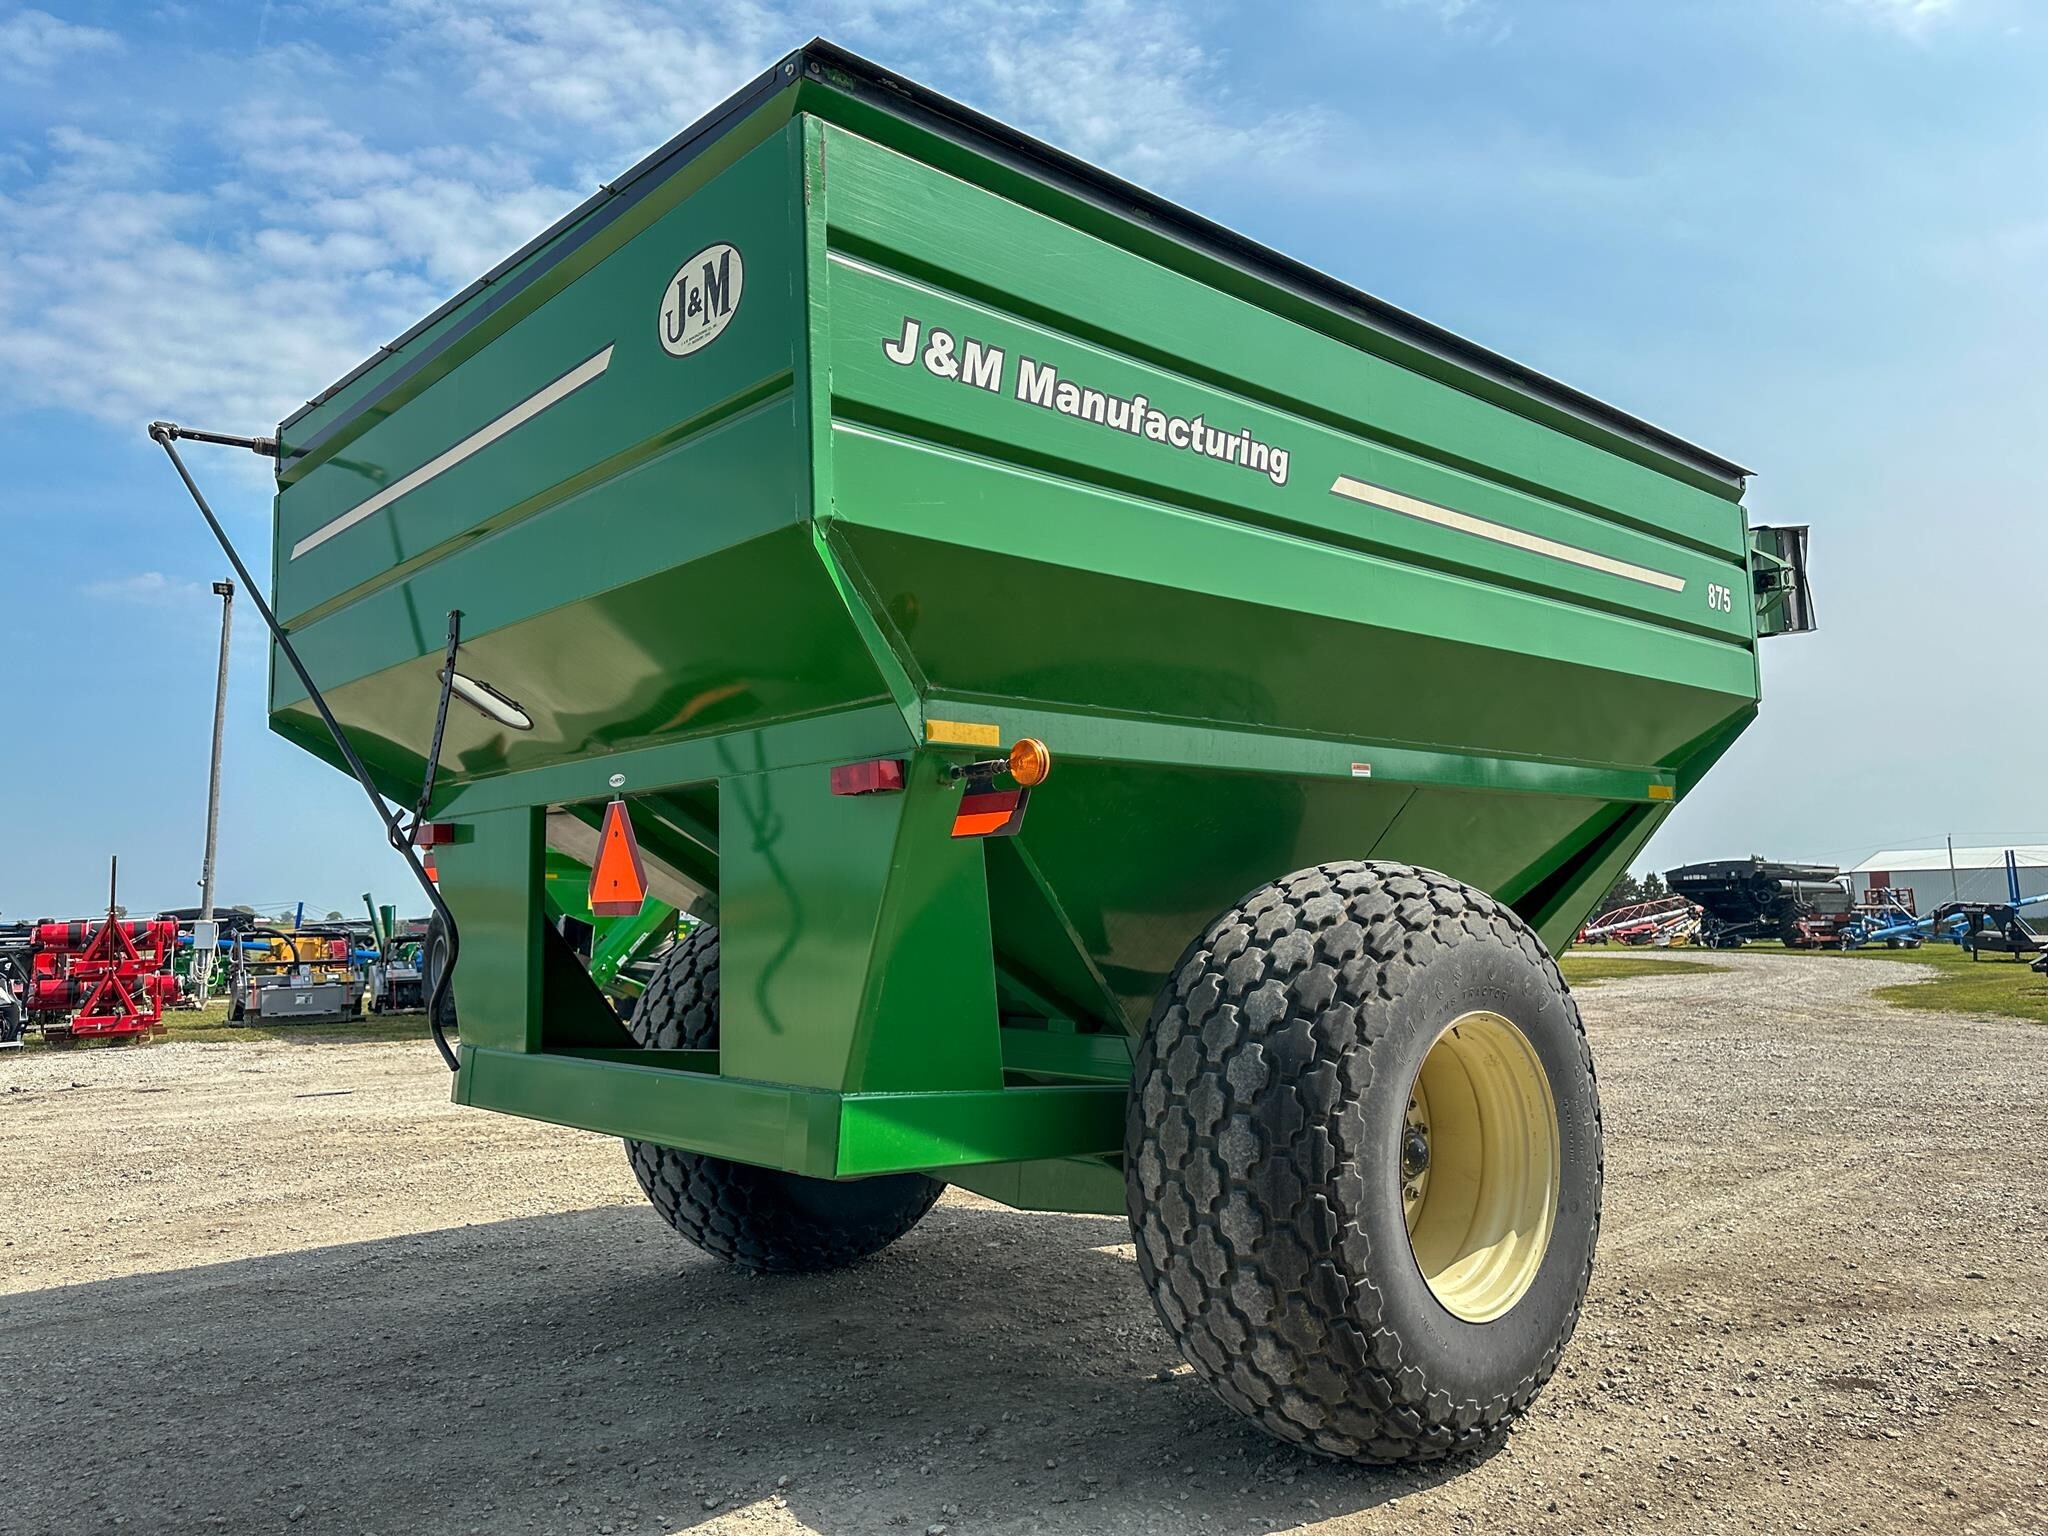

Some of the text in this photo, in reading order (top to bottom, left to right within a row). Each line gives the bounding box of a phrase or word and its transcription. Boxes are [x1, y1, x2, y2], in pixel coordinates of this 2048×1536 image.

[665, 248, 732, 343] J&M
[882, 316, 1290, 487] J&M Manufacturing
[1708, 583, 1731, 613] 875
